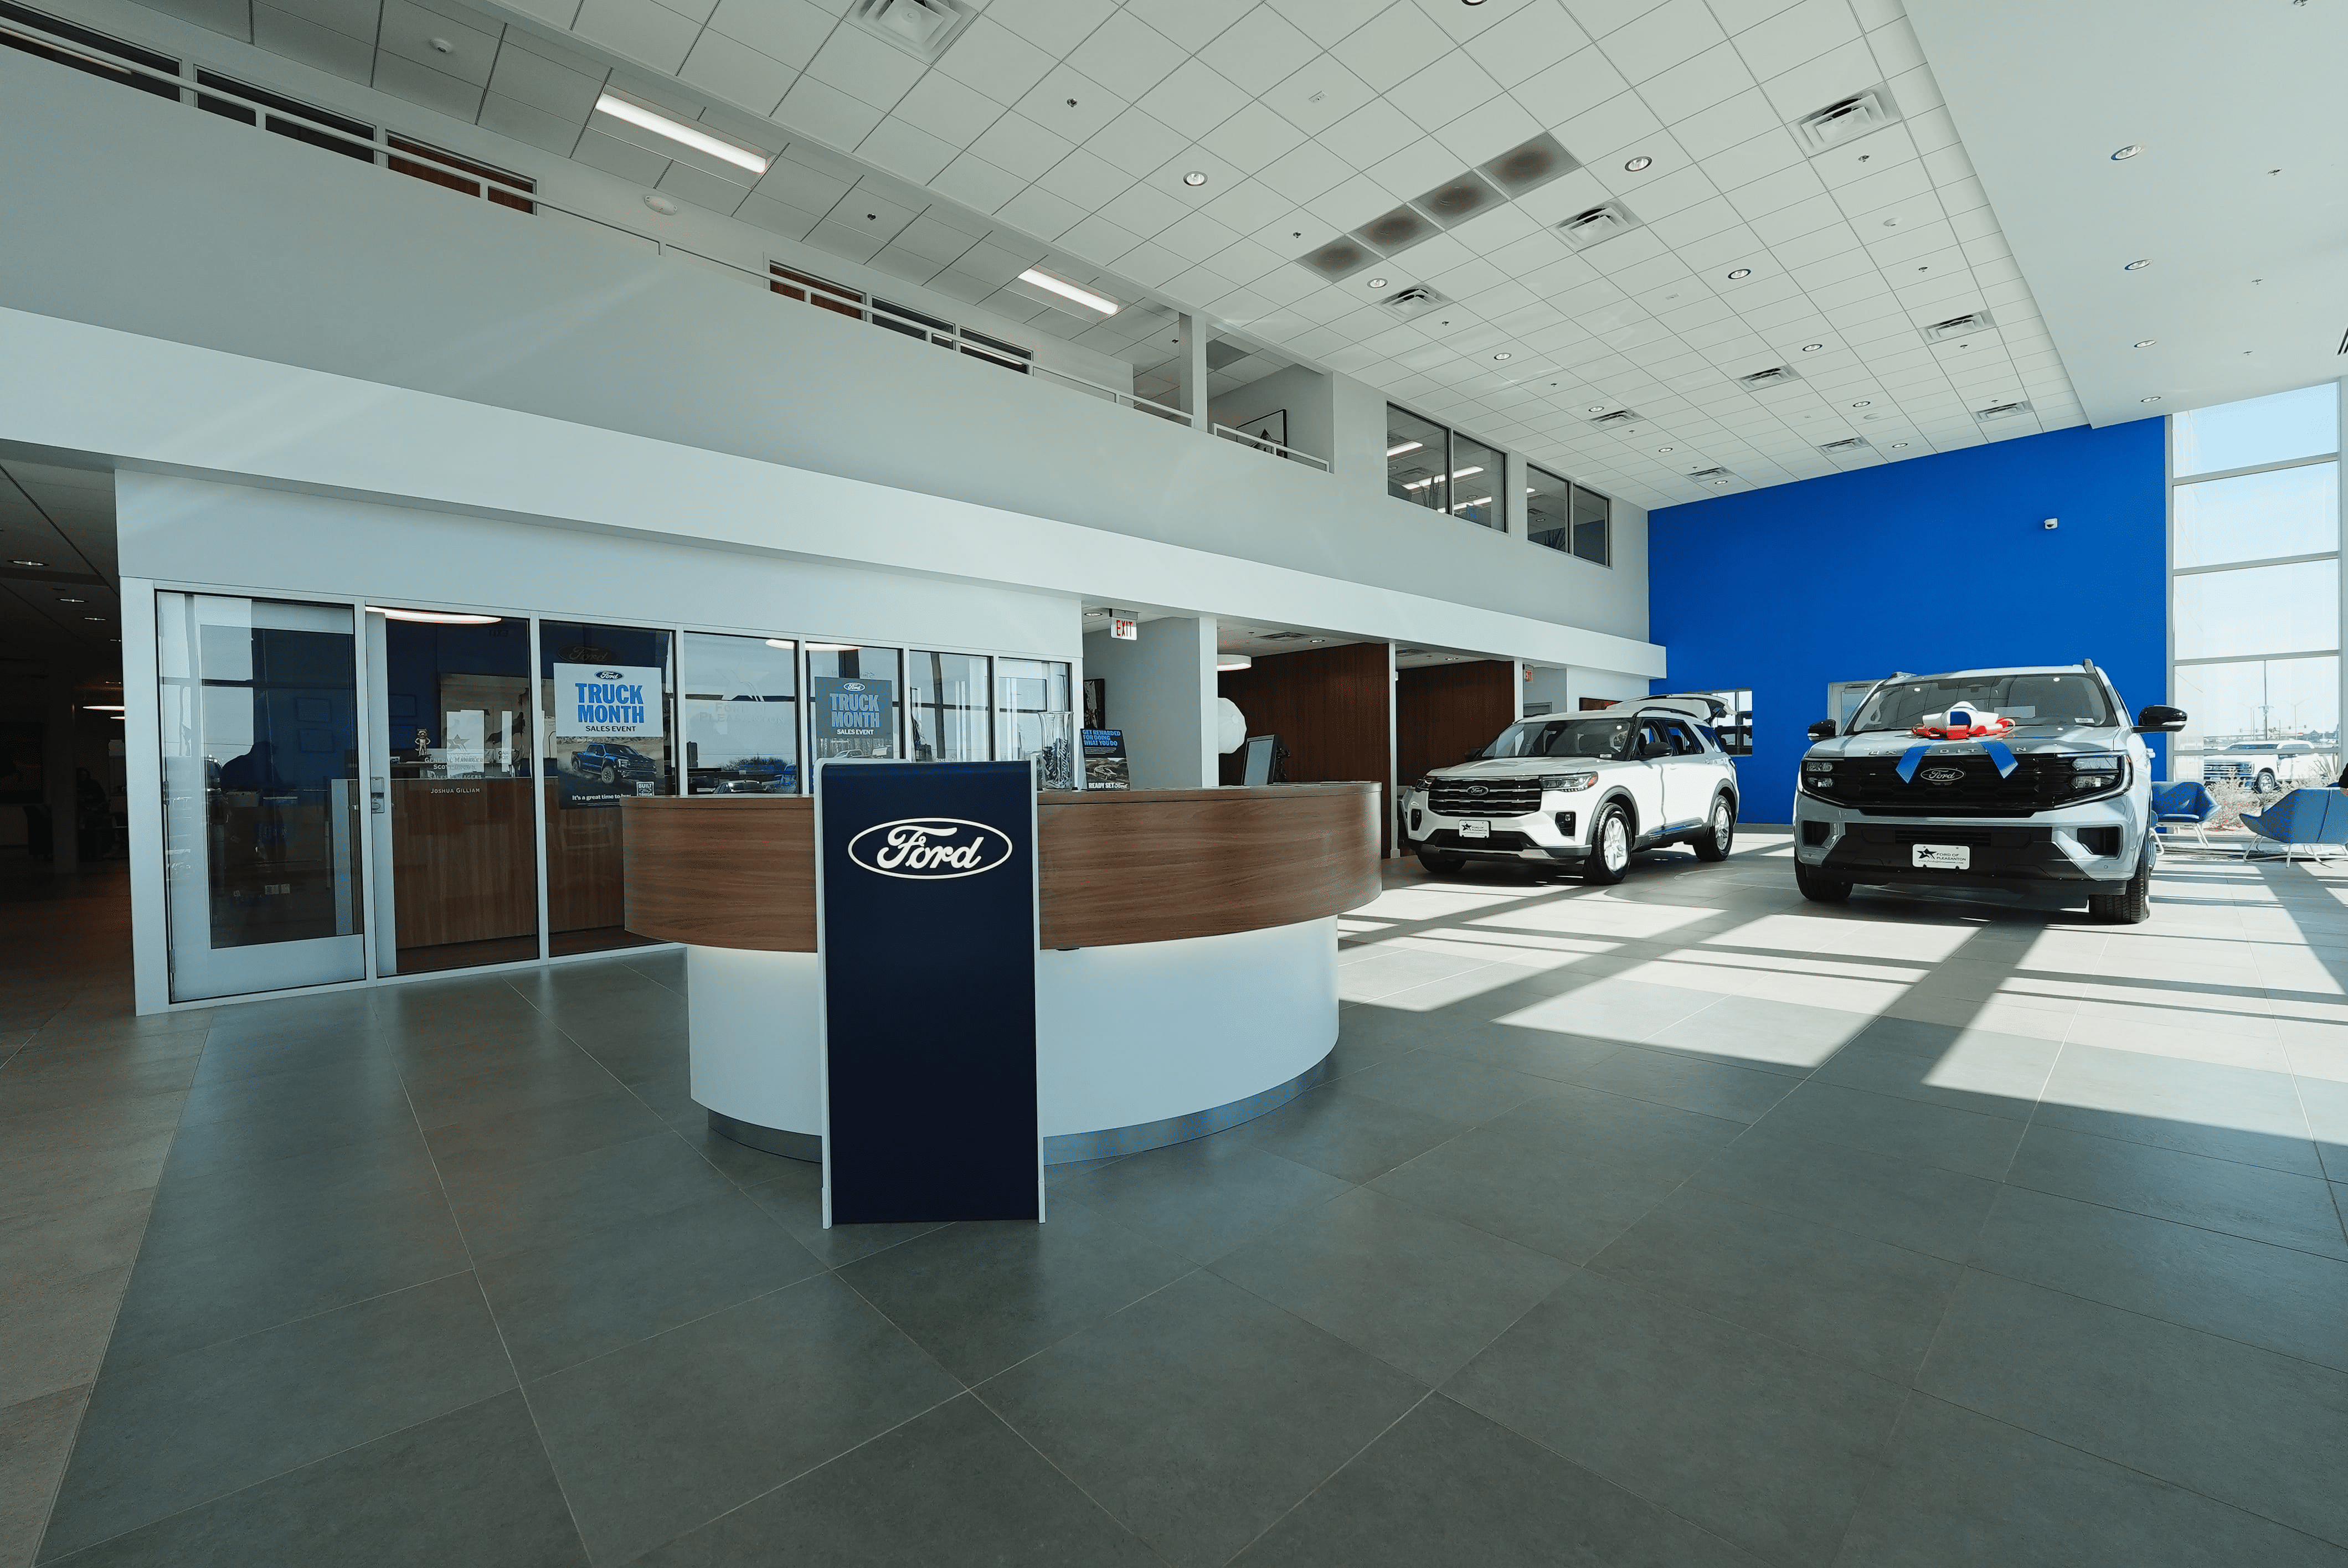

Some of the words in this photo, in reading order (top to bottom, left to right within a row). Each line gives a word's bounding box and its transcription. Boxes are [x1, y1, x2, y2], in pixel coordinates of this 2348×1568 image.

[1116, 620, 1133, 637] EXIT
[600, 671, 619, 680] Ford
[575, 683, 644, 704] TRUCK
[829, 693, 880, 712] TRUCK
[578, 704, 645, 723] MONTH
[831, 711, 881, 728] MONTH
[1868, 746, 2027, 756] EXEDITN
[1928, 770, 1955, 780] Ford
[877, 825, 985, 869] Ford
